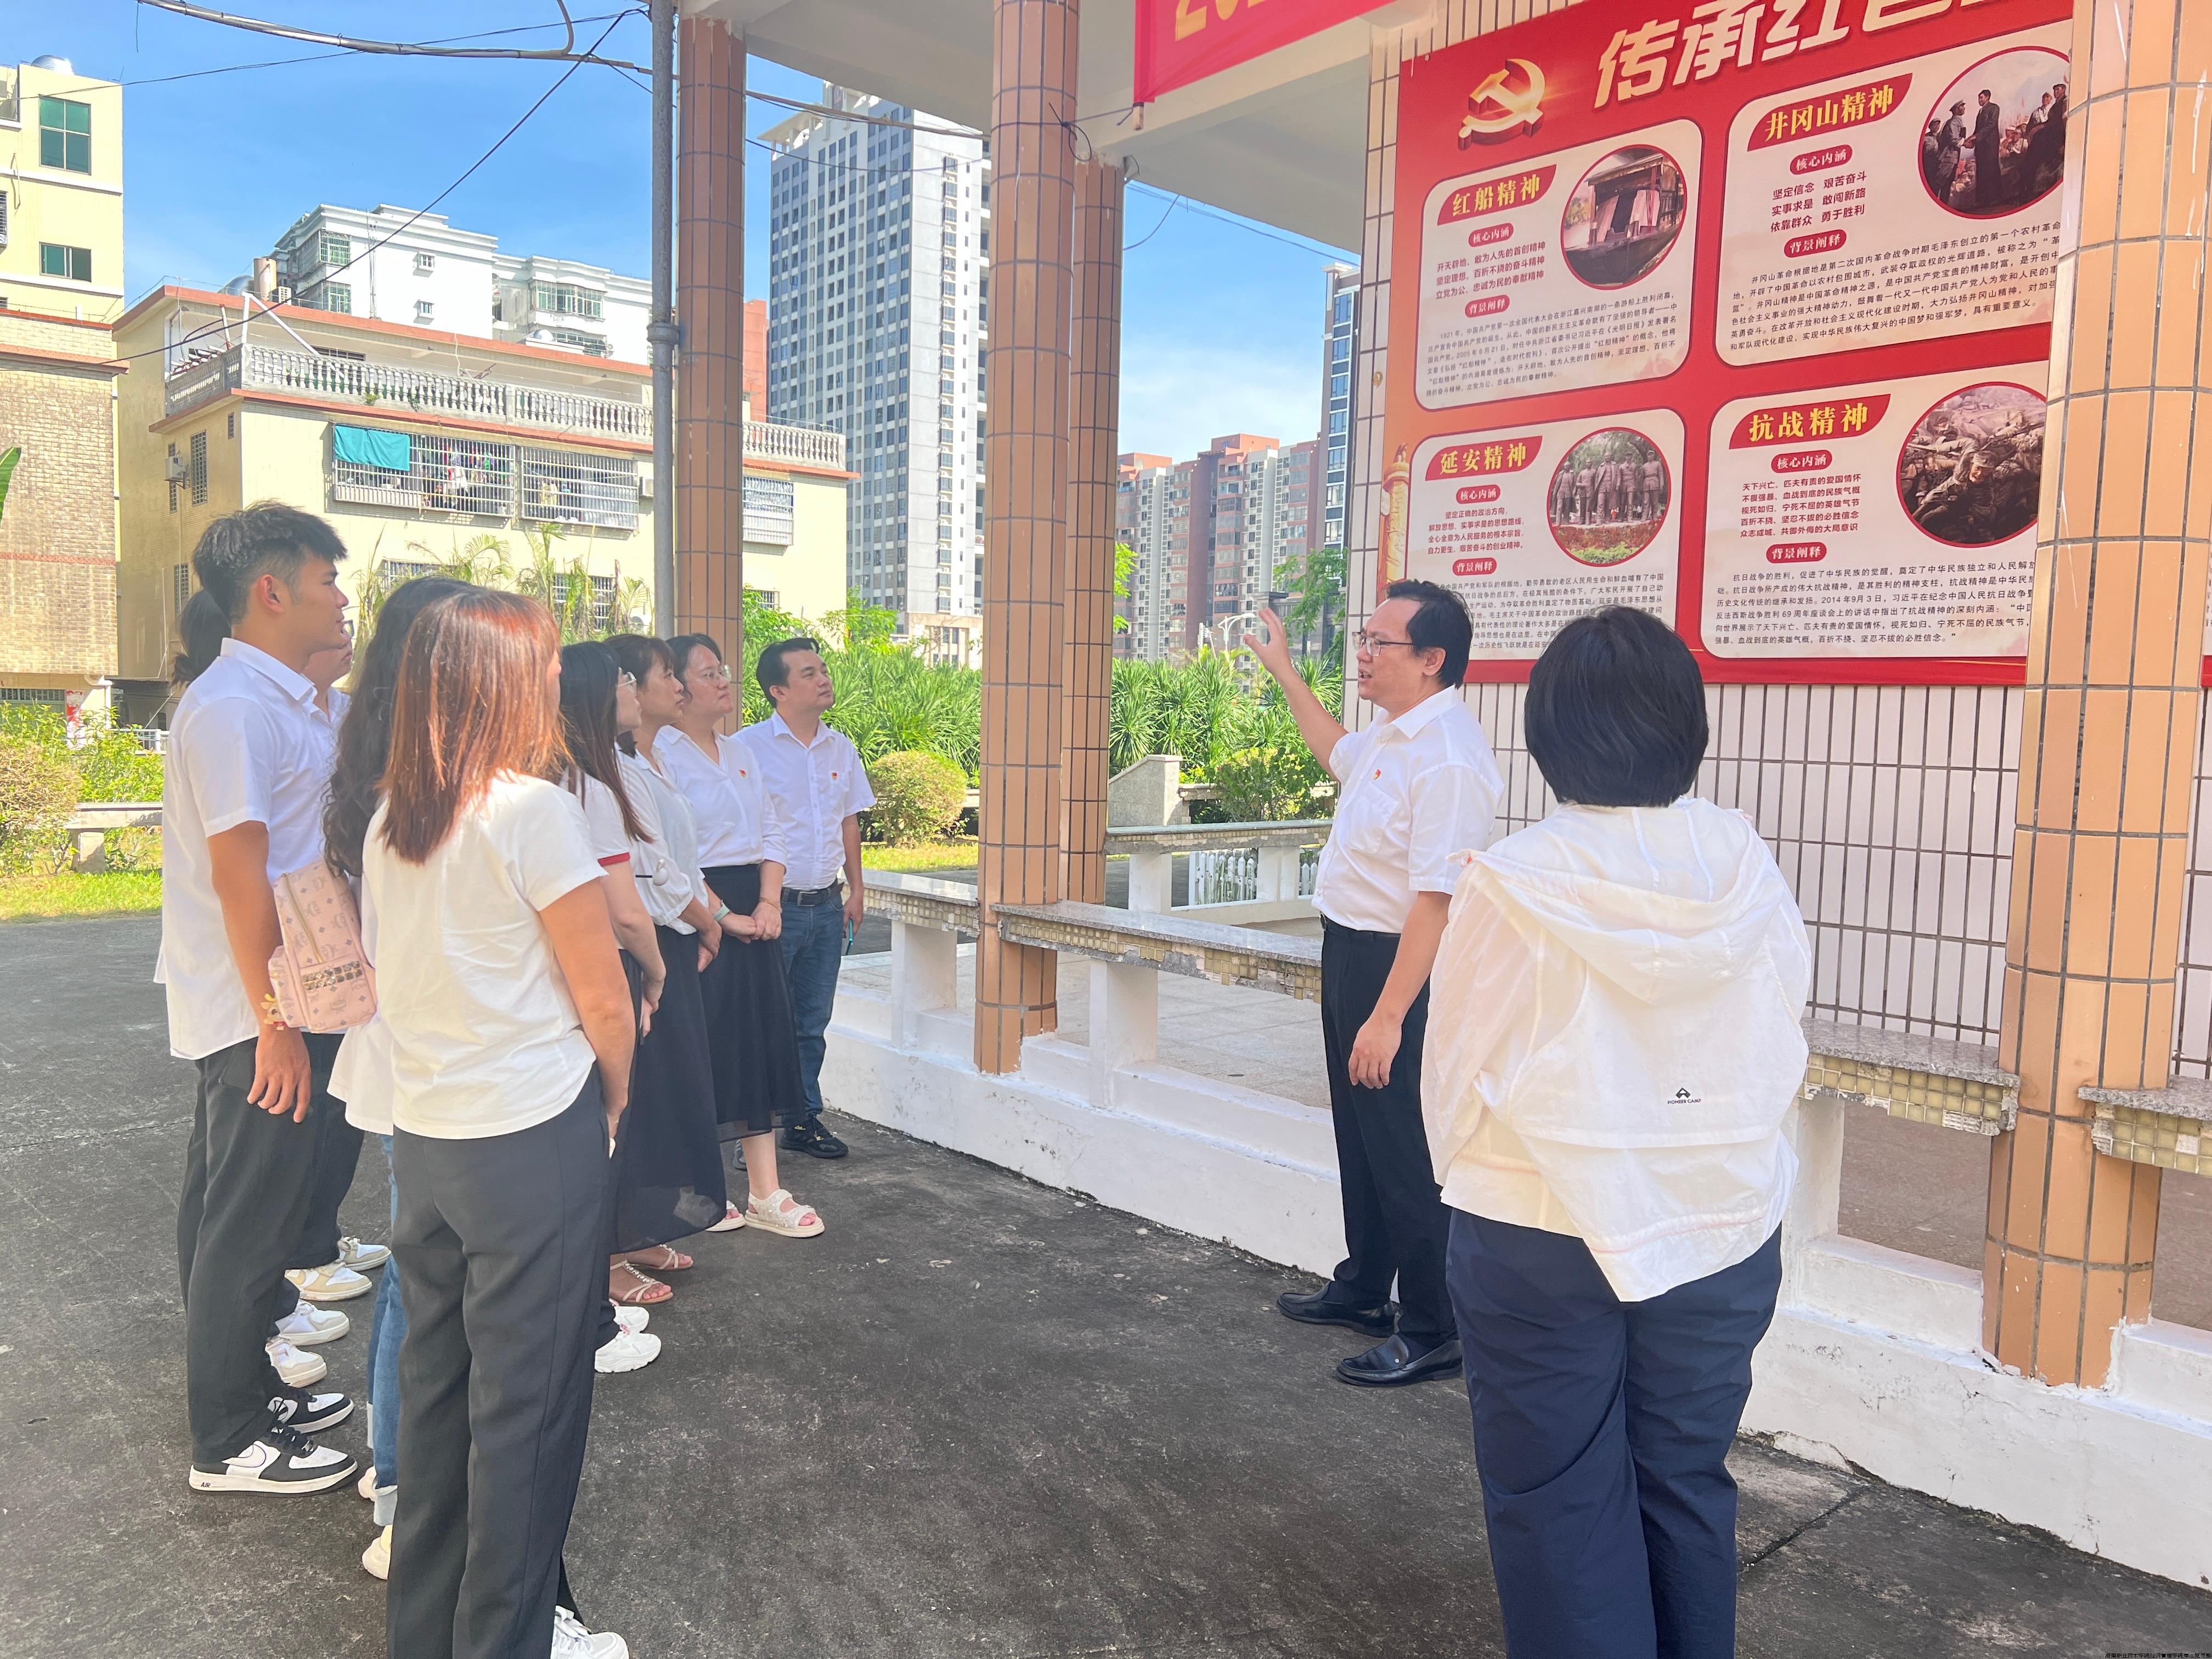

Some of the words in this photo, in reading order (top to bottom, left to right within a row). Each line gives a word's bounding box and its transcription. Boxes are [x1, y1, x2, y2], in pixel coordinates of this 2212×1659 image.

[1765, 84, 1894, 142] 井冈山精神
[1796, 149, 1847, 171] 核心内涵
[1452, 174, 1541, 216] 红船精神
[1773, 182, 1814, 200] 坚定信念
[1824, 171, 1867, 189] 艰苦奋斗
[1772, 199, 1813, 216] 实事求是
[1822, 188, 1866, 206] 敢闯新路
[1771, 215, 1813, 233] 依靠群众
[1821, 204, 1865, 223] 勇于胜利
[1472, 227, 1510, 244] 核心内涵
[1790, 233, 1841, 254] 背景阐释
[1469, 298, 1505, 315] 背景阐释
[1749, 403, 1868, 442] 抗战精神
[1440, 442, 1527, 475] 延安精神
[1777, 454, 1826, 470] 核心内涵
[1460, 488, 1497, 501] 核心内涵
[1771, 546, 1821, 560] 背景阐释
[1457, 561, 1493, 572] 背景阐释
